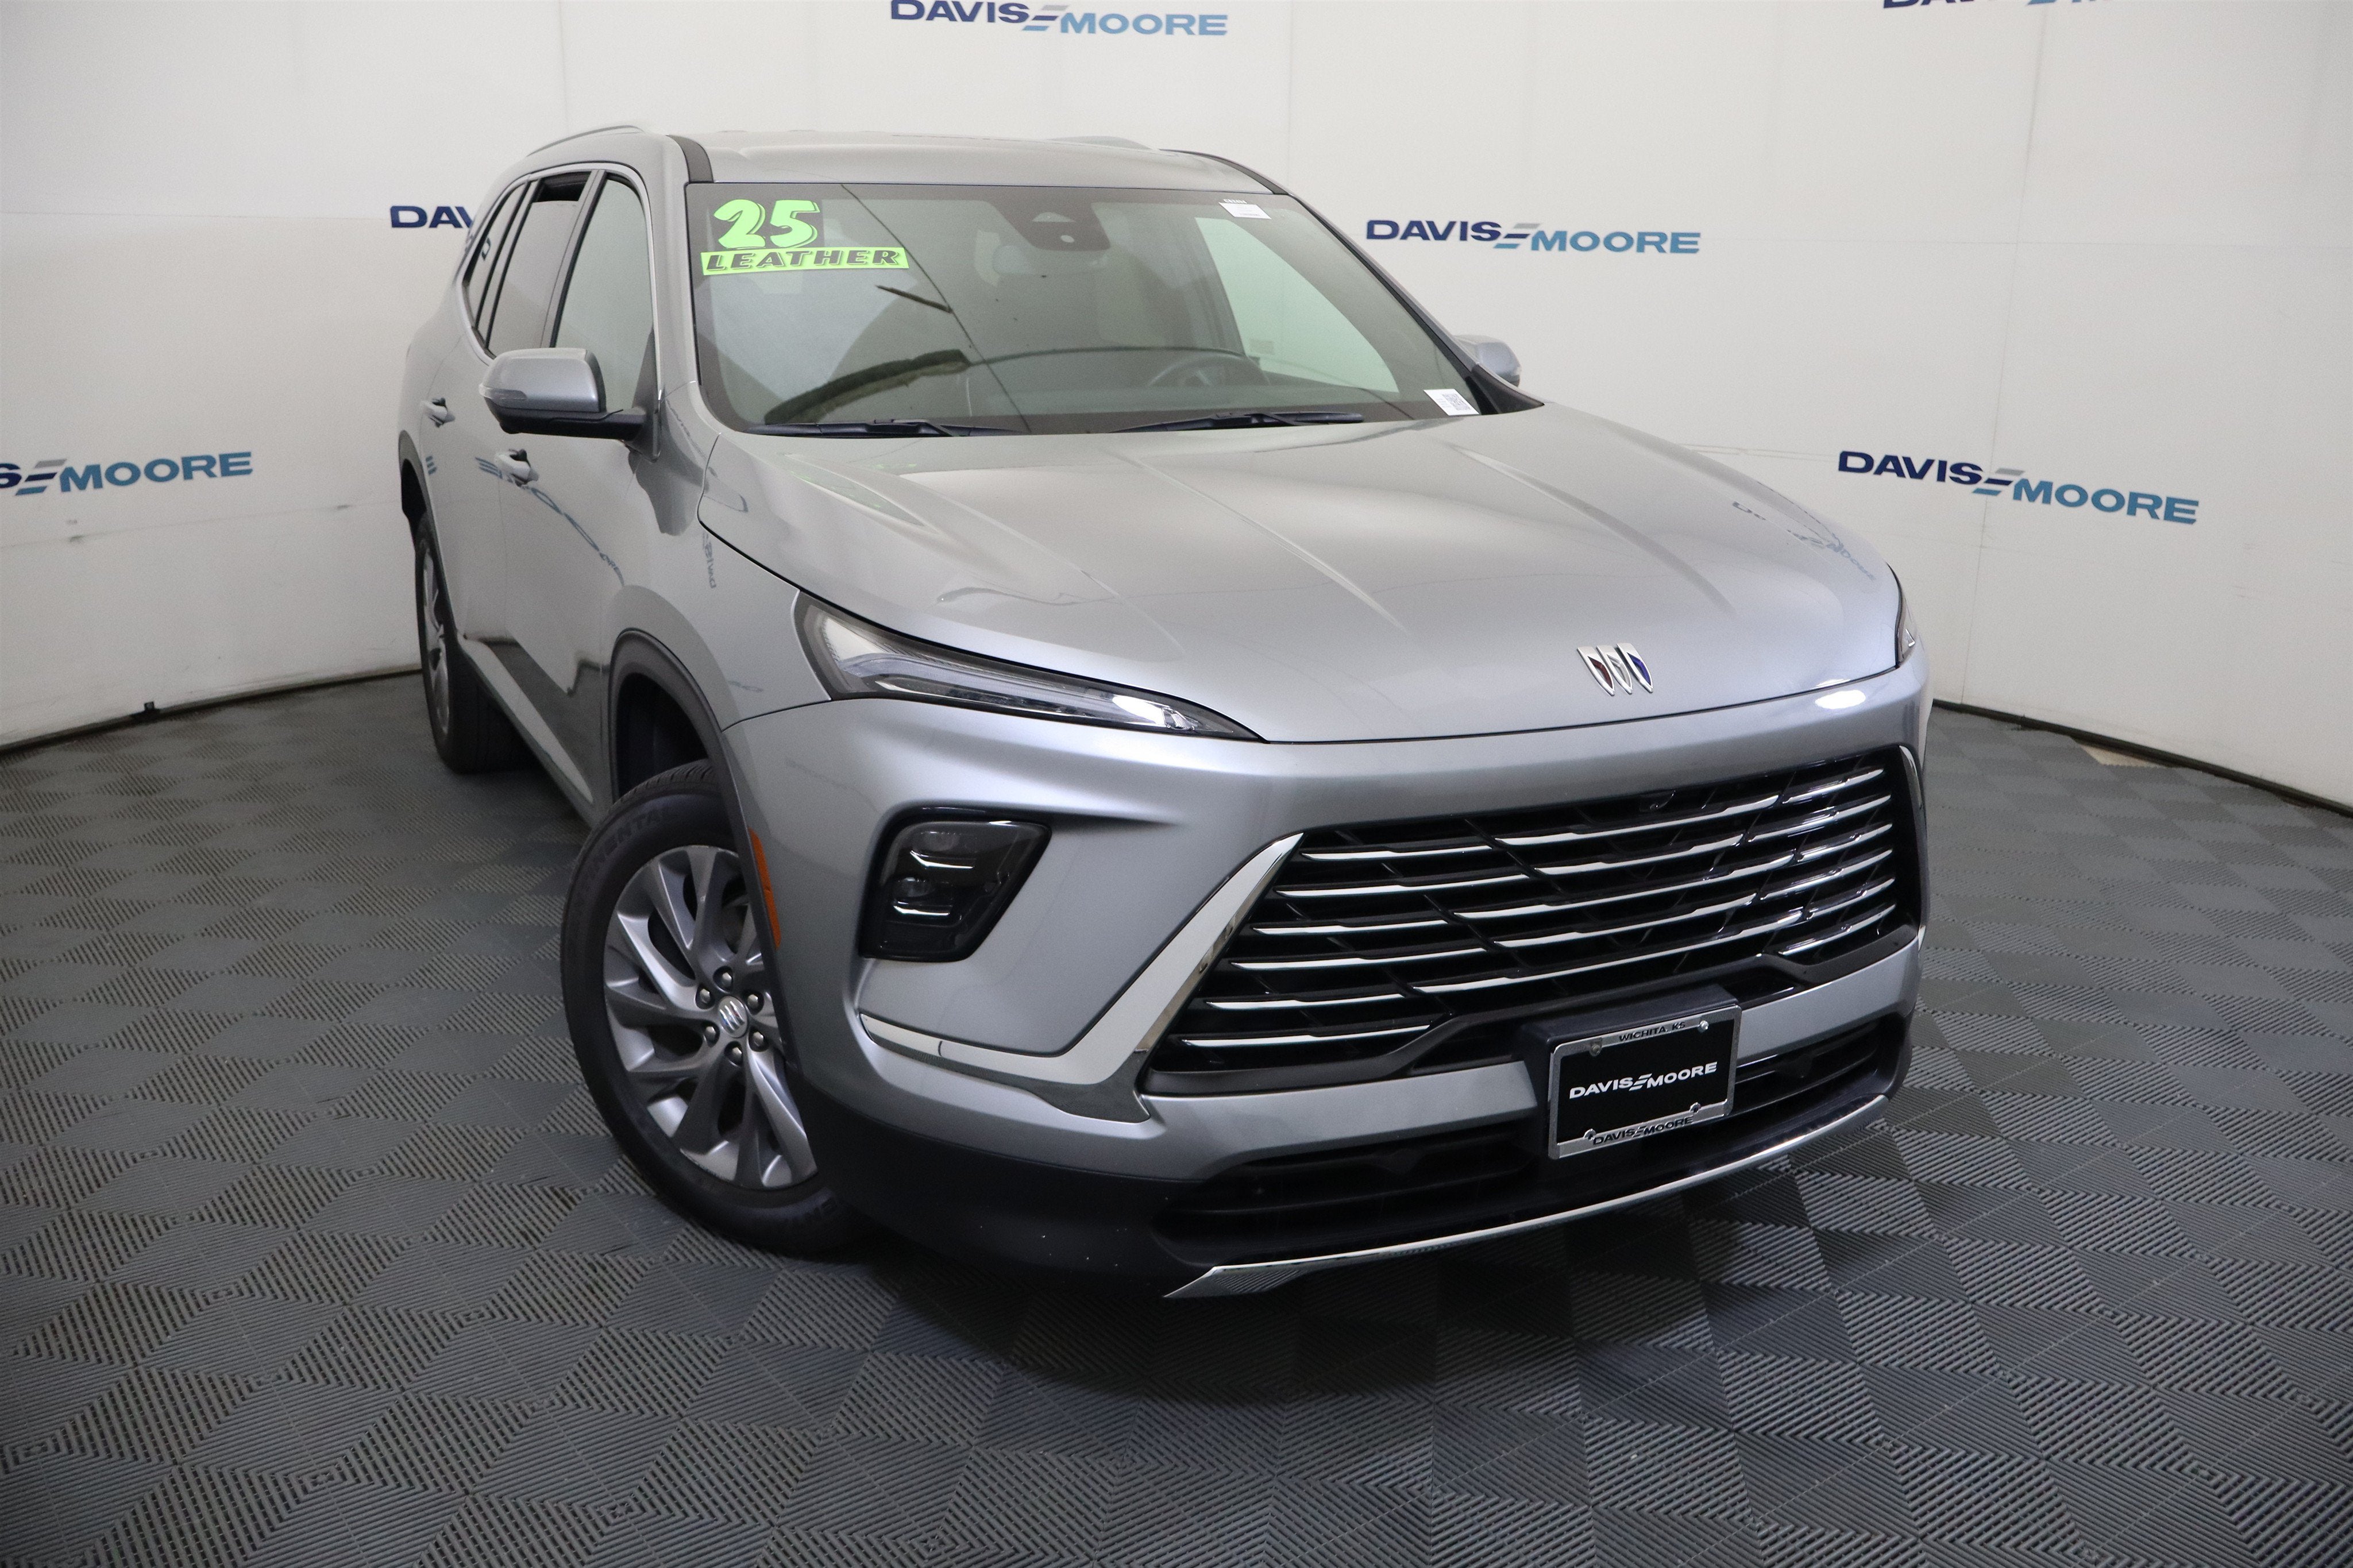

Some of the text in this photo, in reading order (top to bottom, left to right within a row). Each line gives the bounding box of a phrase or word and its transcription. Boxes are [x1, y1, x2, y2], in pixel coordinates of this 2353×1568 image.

[891, 0, 1228, 36] DAVIS MOORE
[390, 205, 474, 228] DAV
[713, 199, 820, 249] 25
[1366, 219, 1701, 254] DAVIS MOORE
[706, 249, 899, 272] LEATHER
[59, 451, 254, 493] MOORE
[1838, 450, 2200, 525] DAVIS MOORE
[1672, 1021, 1685, 1030] KS
[1569, 1061, 1718, 1099] DAVIS MOORE
[1592, 1115, 1694, 1145] DAVIS MOORE
